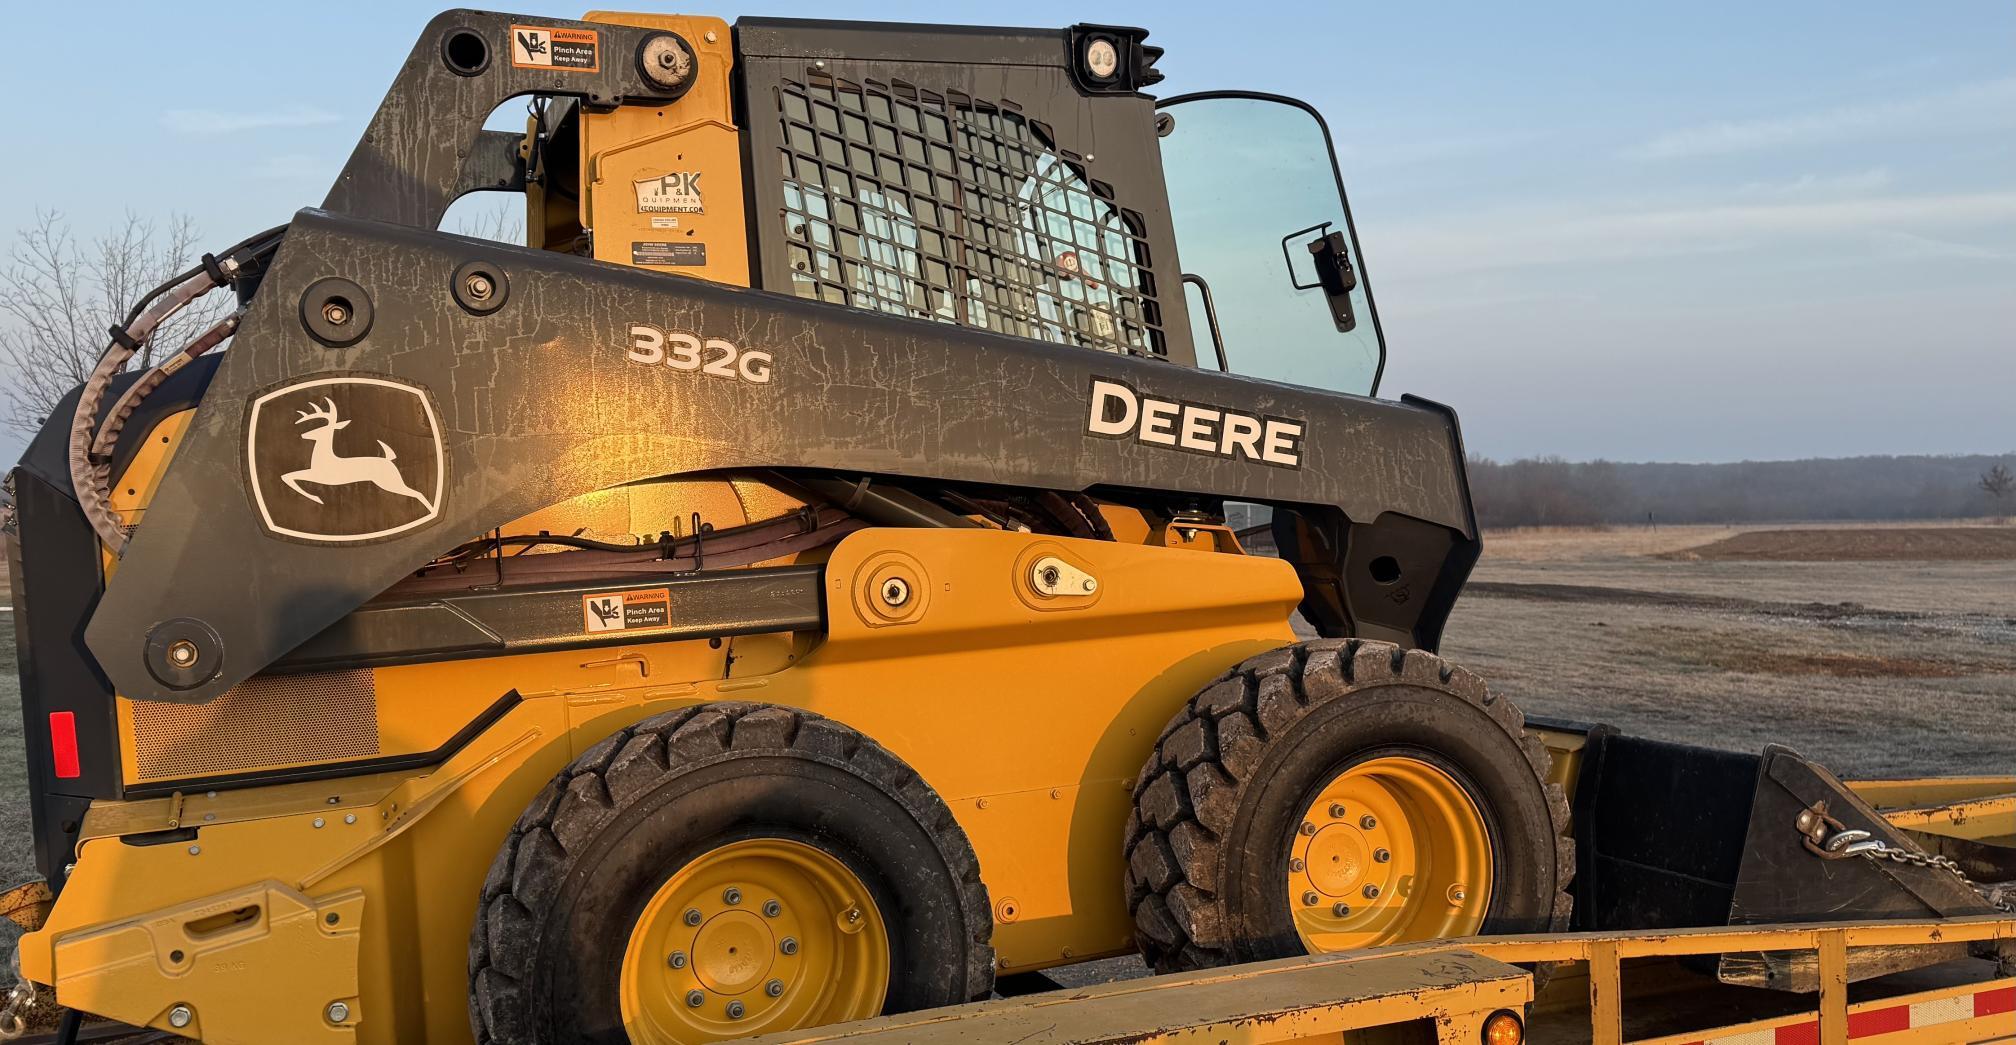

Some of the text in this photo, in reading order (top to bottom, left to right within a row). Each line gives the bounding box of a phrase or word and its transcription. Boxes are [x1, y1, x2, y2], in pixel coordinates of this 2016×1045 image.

[561, 32, 593, 40] WARNING
[554, 46, 593, 55] Pinch Area
[554, 55, 588, 64] Keep Away
[629, 327, 772, 383] 332G
[1089, 381, 1301, 466] DEERE
[632, 592, 665, 601] WARNING
[626, 608, 646, 616] Pinch
